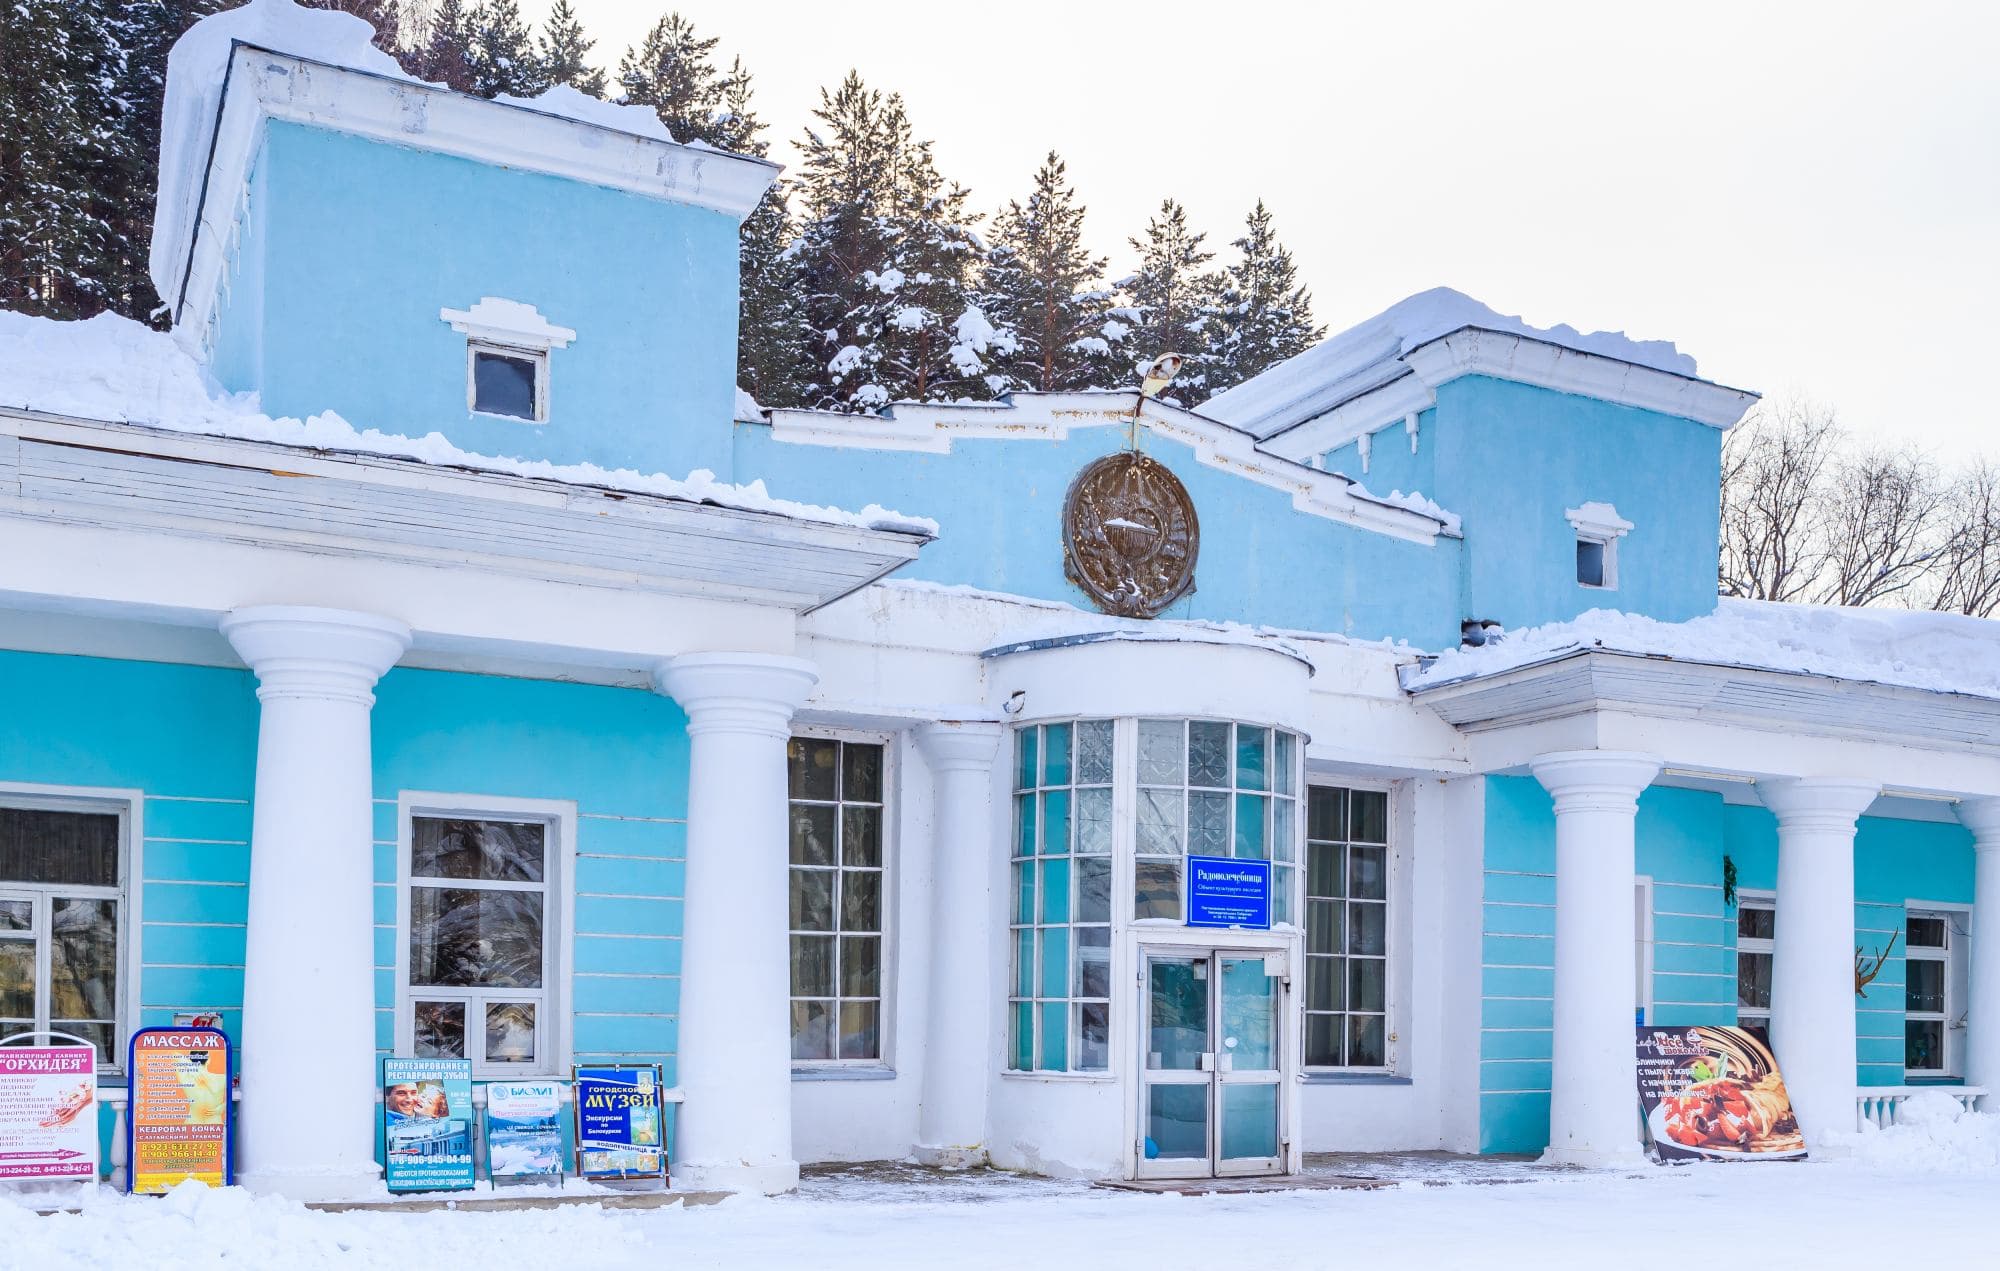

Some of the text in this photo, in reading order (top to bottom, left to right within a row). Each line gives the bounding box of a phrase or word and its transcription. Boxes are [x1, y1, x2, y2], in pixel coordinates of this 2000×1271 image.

[142, 1035, 219, 1047] МАССАЖ
[387, 1062, 462, 1070] ПРОТЕЗИРОВАНИЕ
[387, 1071, 469, 1080] РЕСТАВРАЦИЯ ЗУБОВ
[511, 1087, 553, 1096] БИОЛИТ
